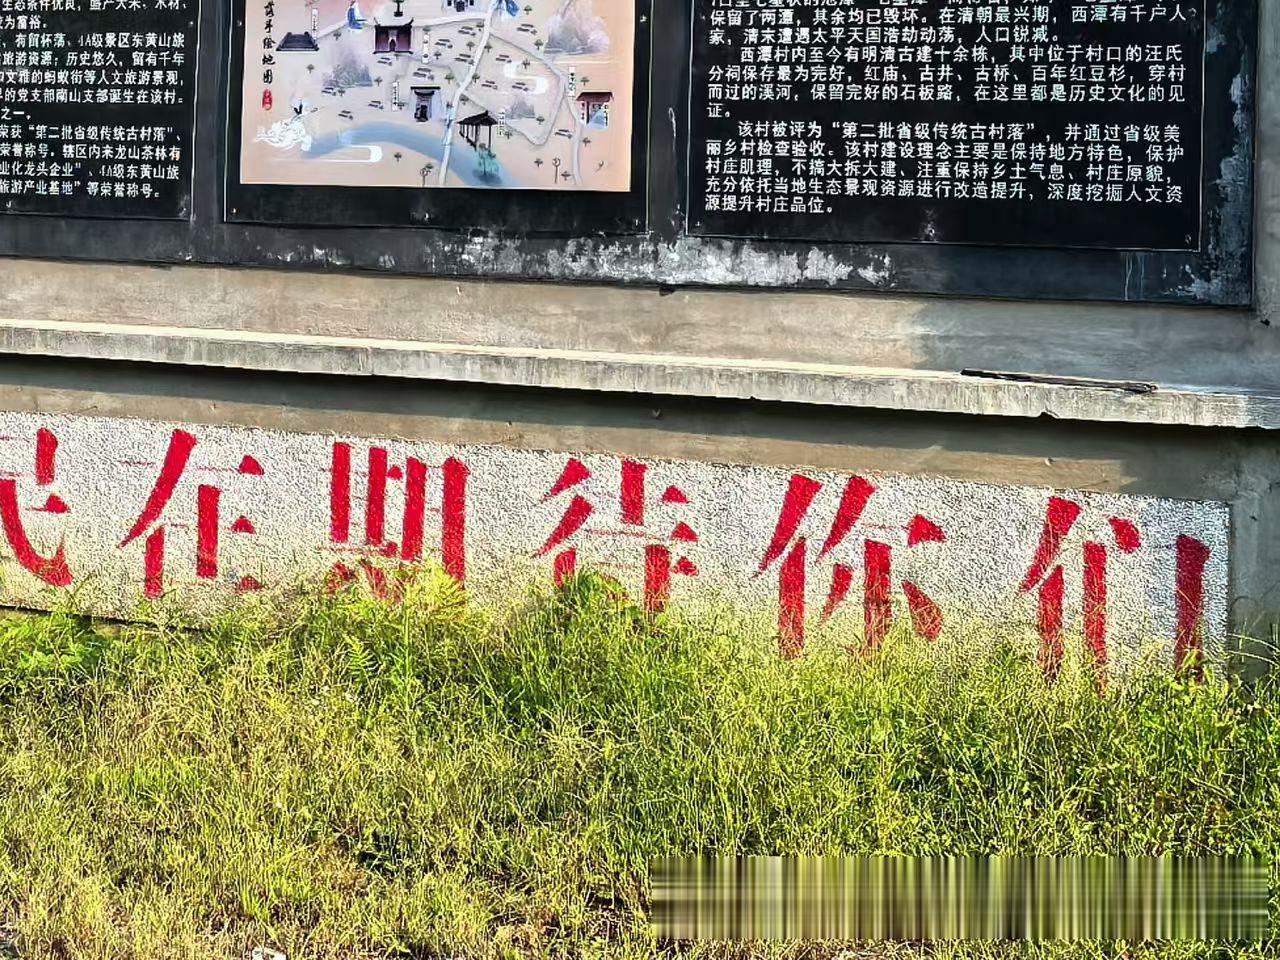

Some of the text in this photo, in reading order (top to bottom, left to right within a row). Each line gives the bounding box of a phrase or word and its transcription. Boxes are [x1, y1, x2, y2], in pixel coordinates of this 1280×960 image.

[707, 102, 731, 118] 证。
[705, 195, 834, 214] 源提升村庄品位。
